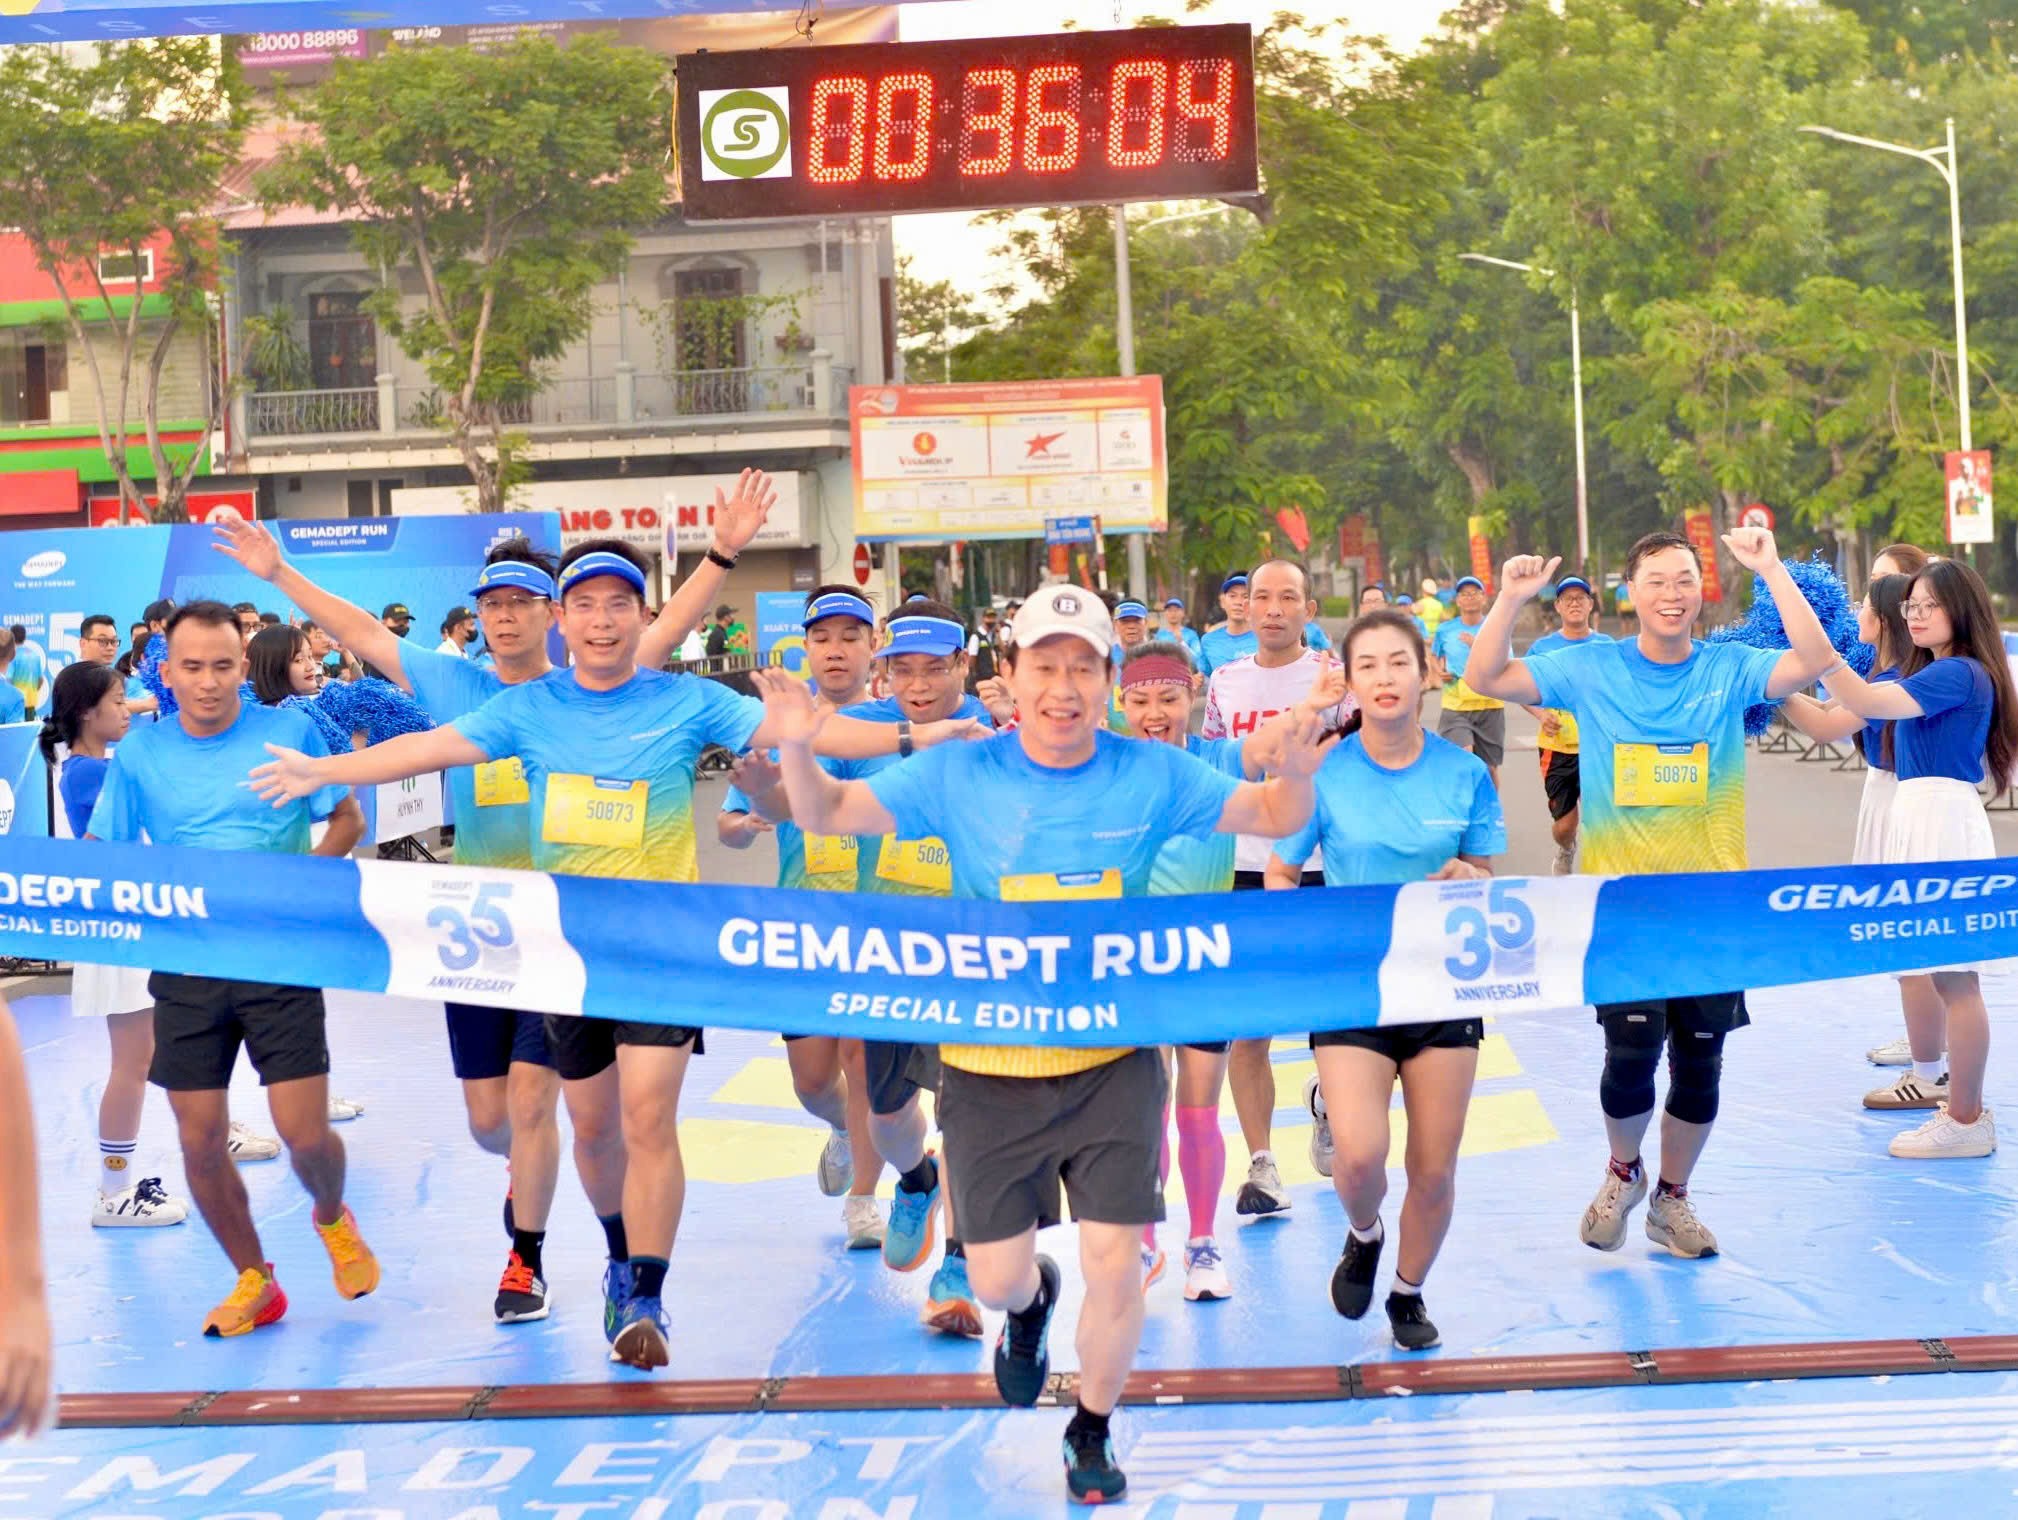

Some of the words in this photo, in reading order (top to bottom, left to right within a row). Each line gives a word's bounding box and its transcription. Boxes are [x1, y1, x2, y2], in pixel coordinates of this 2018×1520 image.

[621, 505, 698, 529] TON
[290, 527, 358, 539] GEMADEPT
[361, 525, 388, 536] RUN
[1654, 766, 1698, 783] 50878
[585, 800, 634, 823] 50873
[112, 880, 209, 919] RUN
[51, 918, 142, 941] EDITION
[427, 882, 515, 971] 35
[1445, 879, 1535, 981] 35
[1850, 917, 1957, 942] SPECIAL
[718, 917, 1071, 985] GEMADEPT
[1091, 923, 1232, 981] RUN
[428, 975, 516, 993] ANNIVERSARY
[1454, 981, 1541, 1001] ANNIVERSARY
[826, 992, 962, 1026] SPECIAL
[974, 1002, 1119, 1034] EDITION
